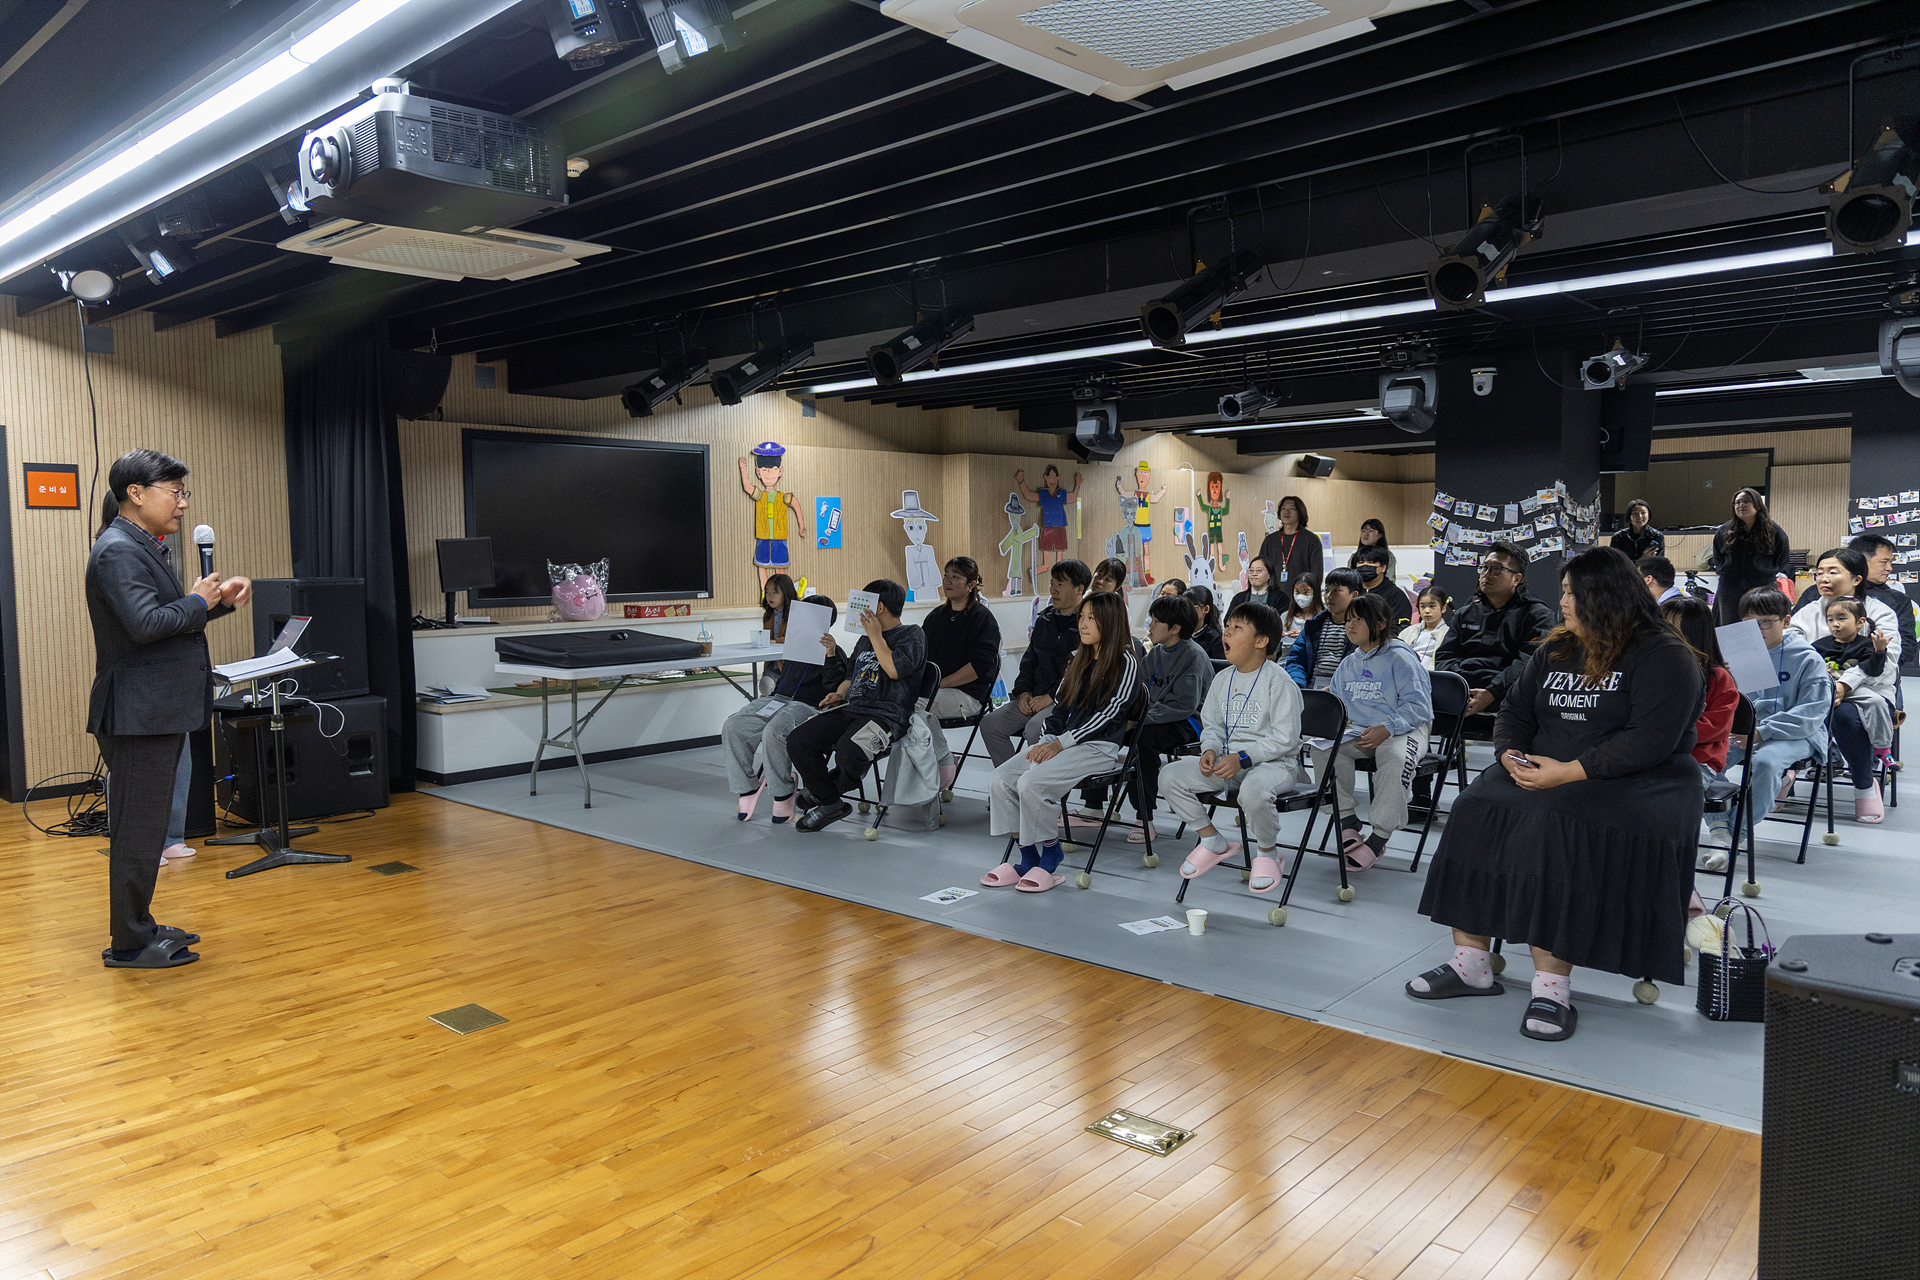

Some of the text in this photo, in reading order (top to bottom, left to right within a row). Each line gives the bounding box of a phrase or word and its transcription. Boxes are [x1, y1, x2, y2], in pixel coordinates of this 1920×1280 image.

[38, 485, 67, 494] 준비실
[1548, 693, 1600, 708] MOMENT
[1221, 700, 1263, 712] GRDEN
[1560, 712, 1587, 721] ORIGINAL
